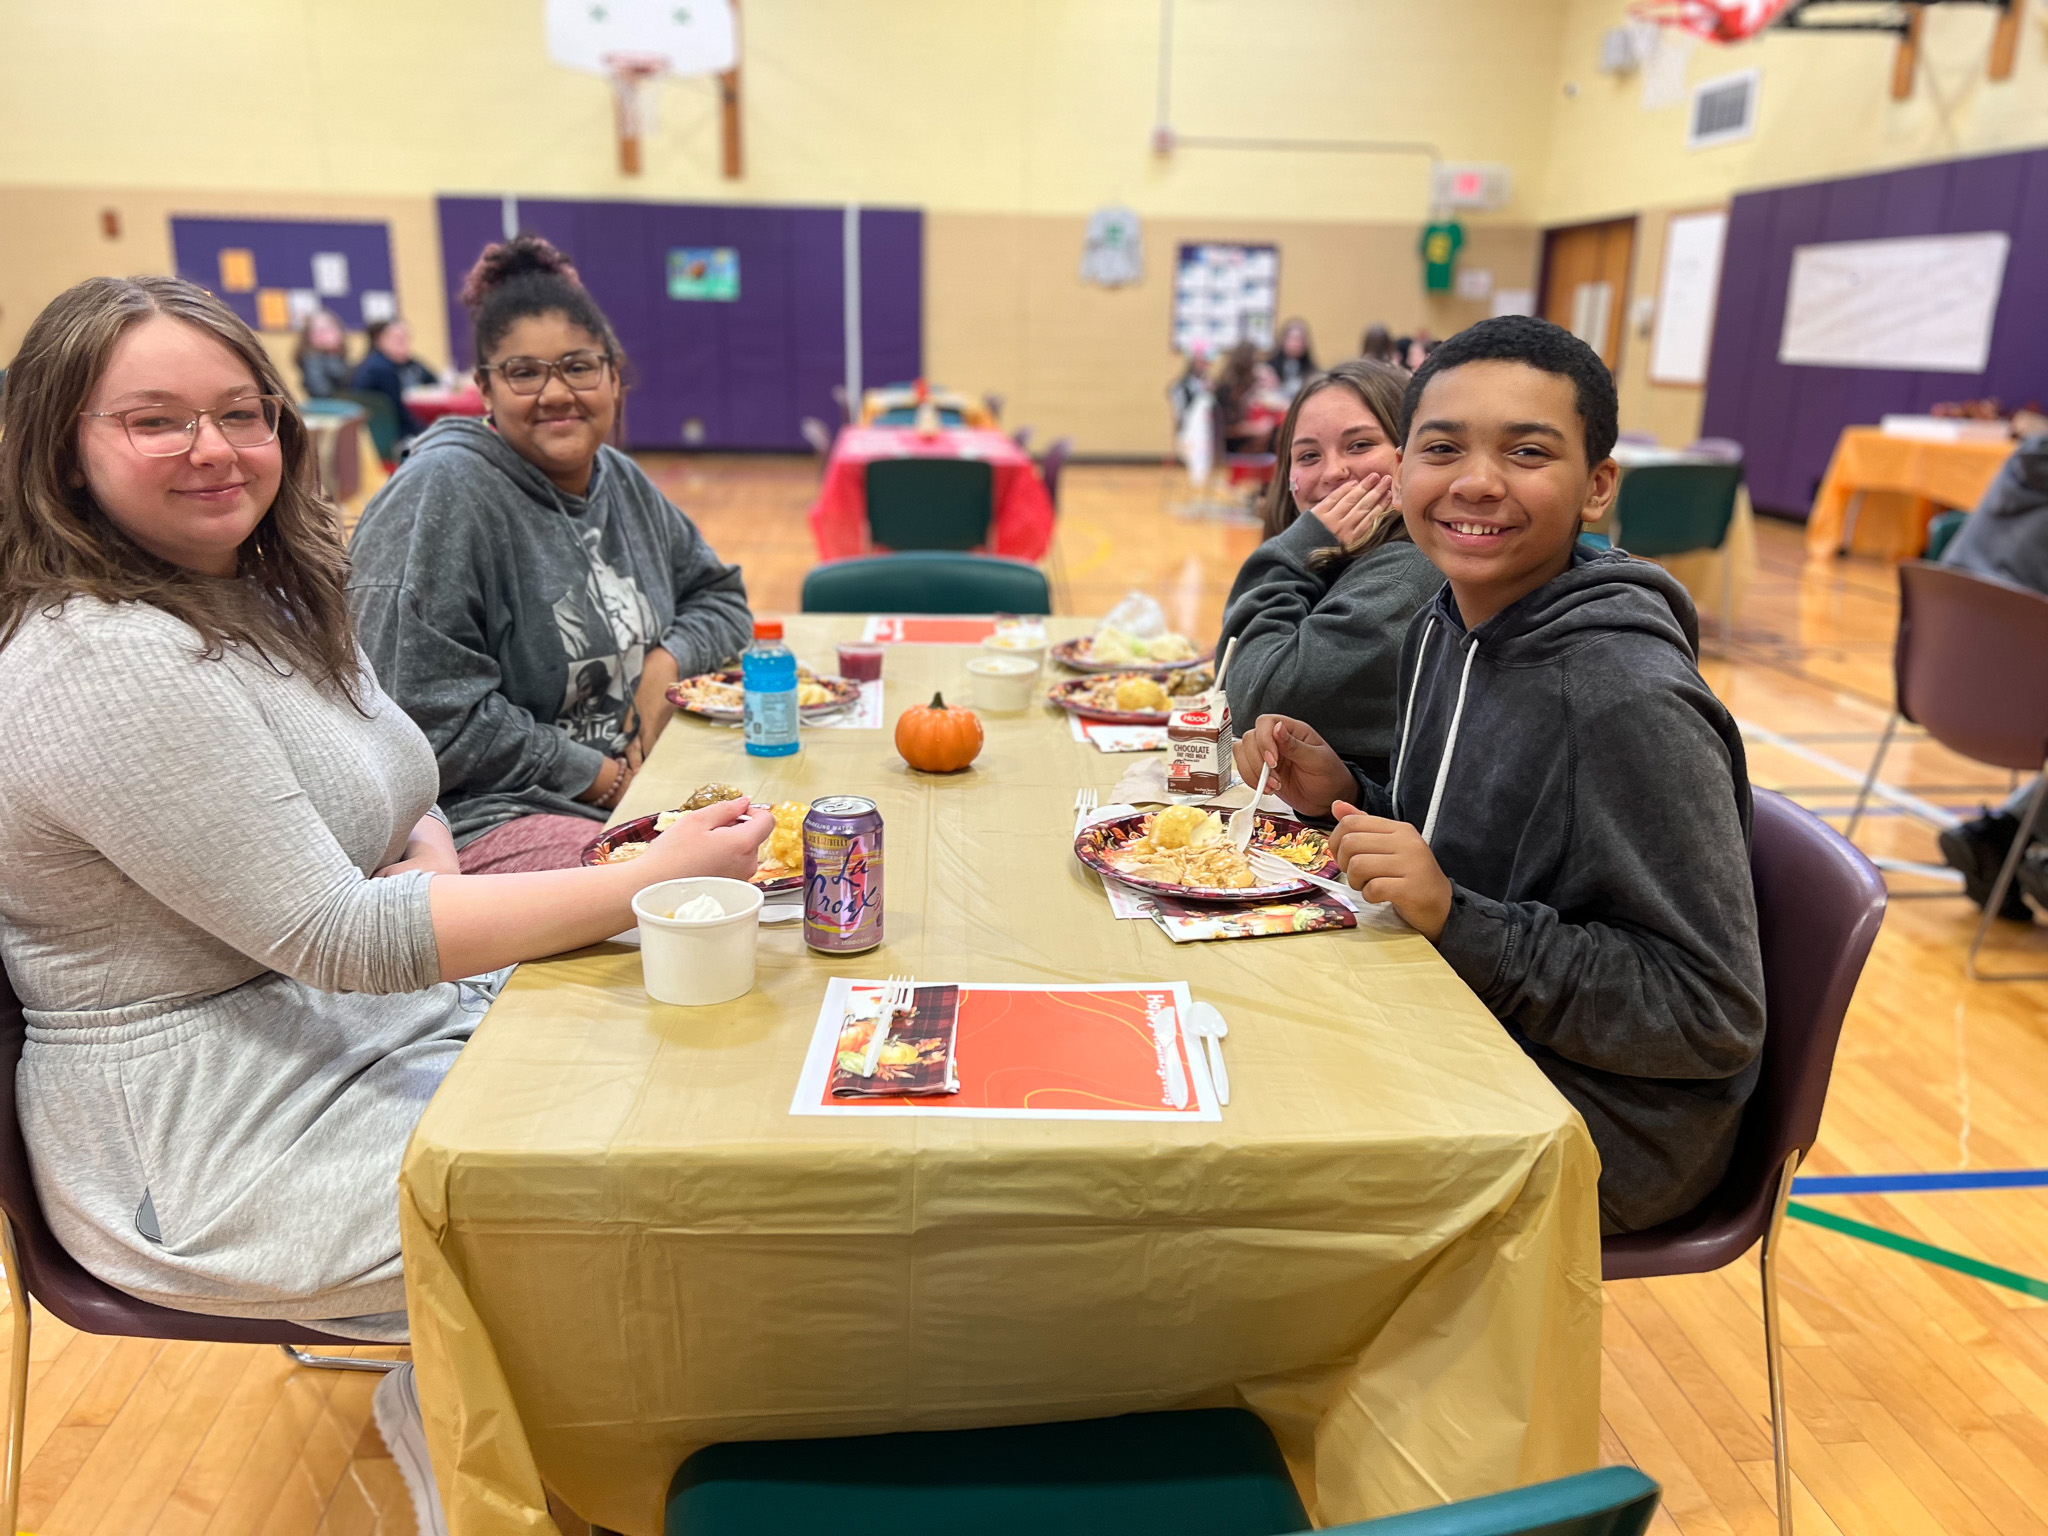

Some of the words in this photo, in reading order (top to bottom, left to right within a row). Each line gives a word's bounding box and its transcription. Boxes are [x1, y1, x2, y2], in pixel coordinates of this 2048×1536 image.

[1183, 714, 1209, 723] Hood
[1174, 744, 1210, 754] CHOCOLATE
[832, 840, 870, 888] La
[806, 874, 878, 923] Croix
